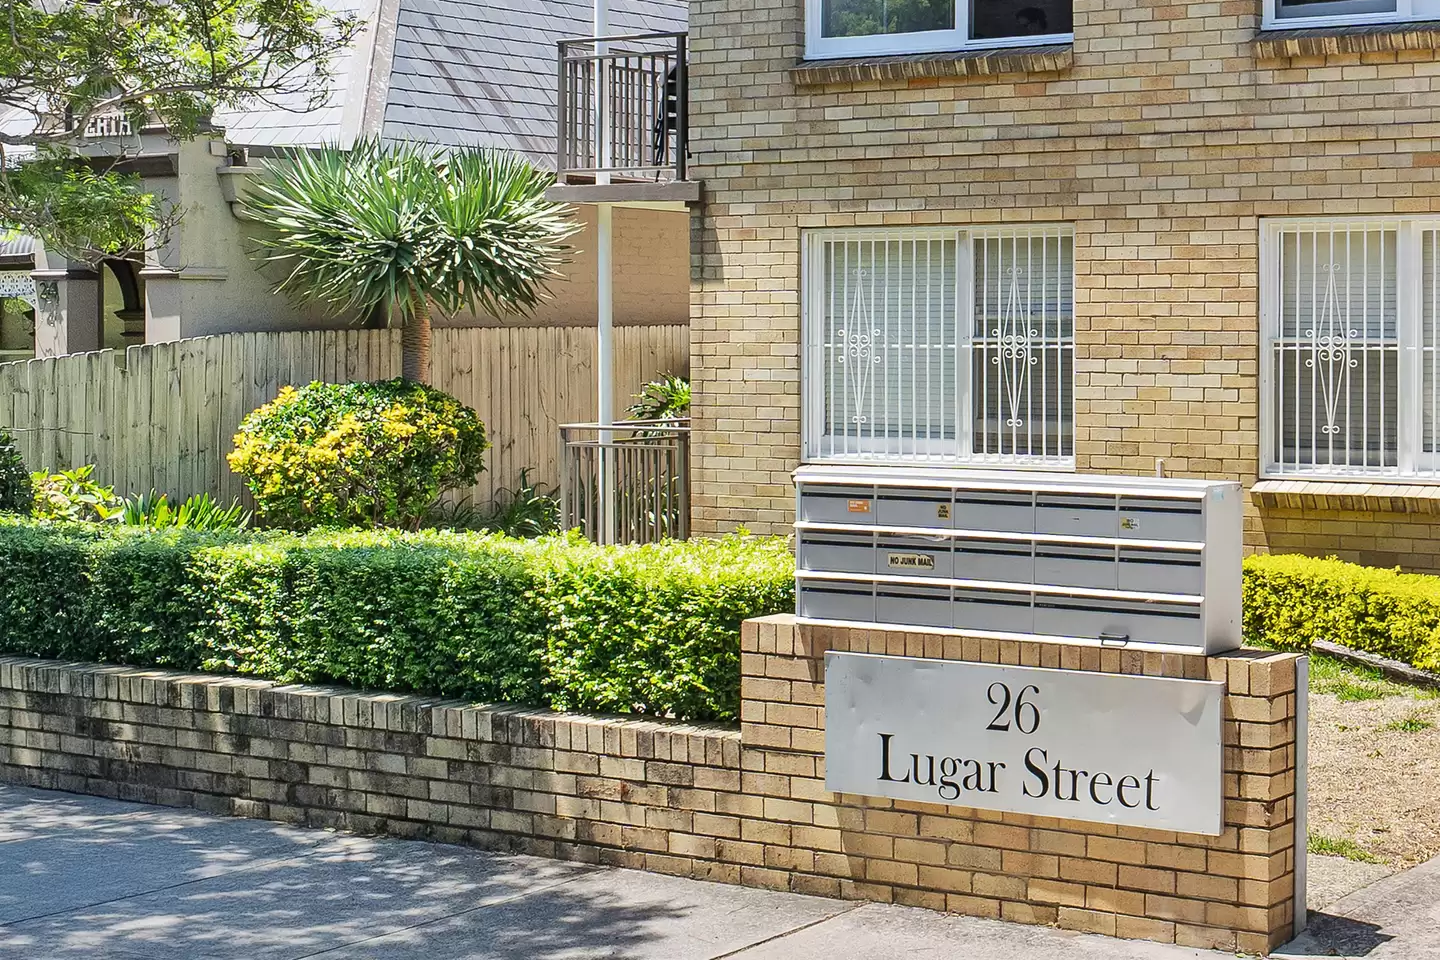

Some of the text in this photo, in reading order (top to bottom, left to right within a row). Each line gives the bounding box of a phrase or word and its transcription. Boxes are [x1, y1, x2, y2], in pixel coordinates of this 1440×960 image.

[890, 557, 932, 567] NO JUNK MAIL
[985, 681, 1040, 735] 26
[876, 732, 1161, 812] Lugar Street
